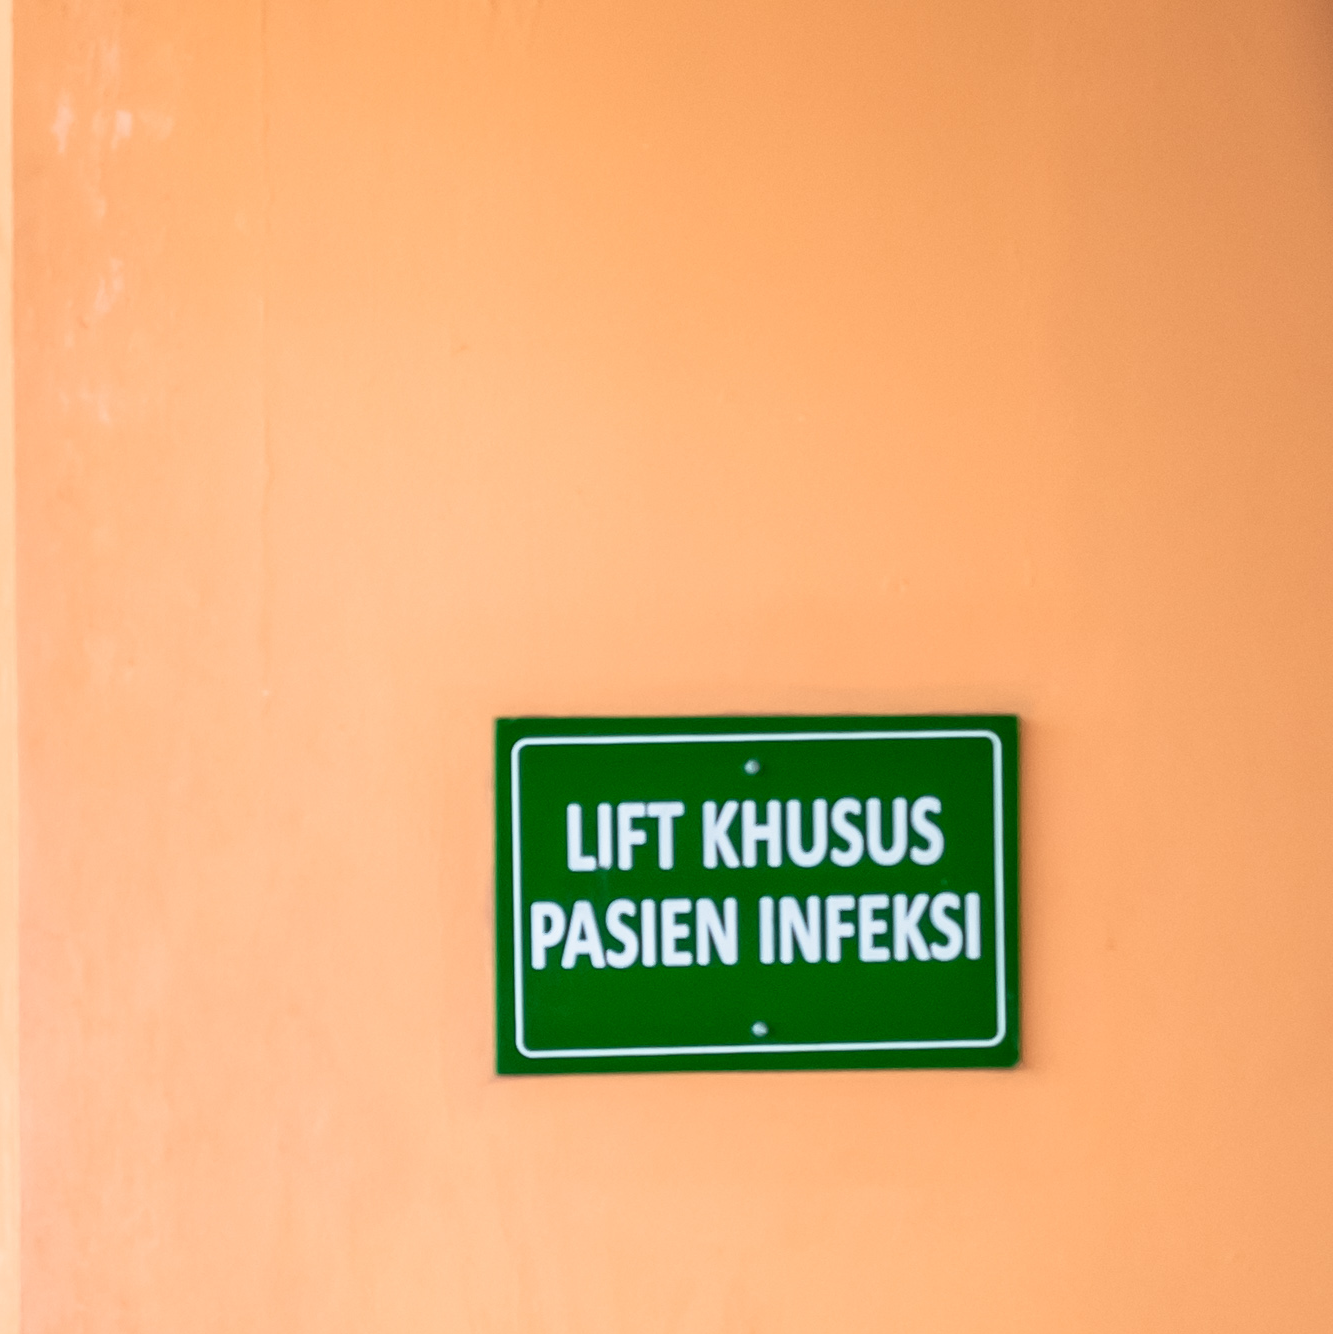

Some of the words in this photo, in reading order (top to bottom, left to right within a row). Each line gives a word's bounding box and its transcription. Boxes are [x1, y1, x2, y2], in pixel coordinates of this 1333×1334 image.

[566, 802, 685, 872] LIFT
[702, 796, 945, 869] KHUSUS
[530, 897, 738, 970] PASIEN
[759, 892, 981, 964] INFEKSI
